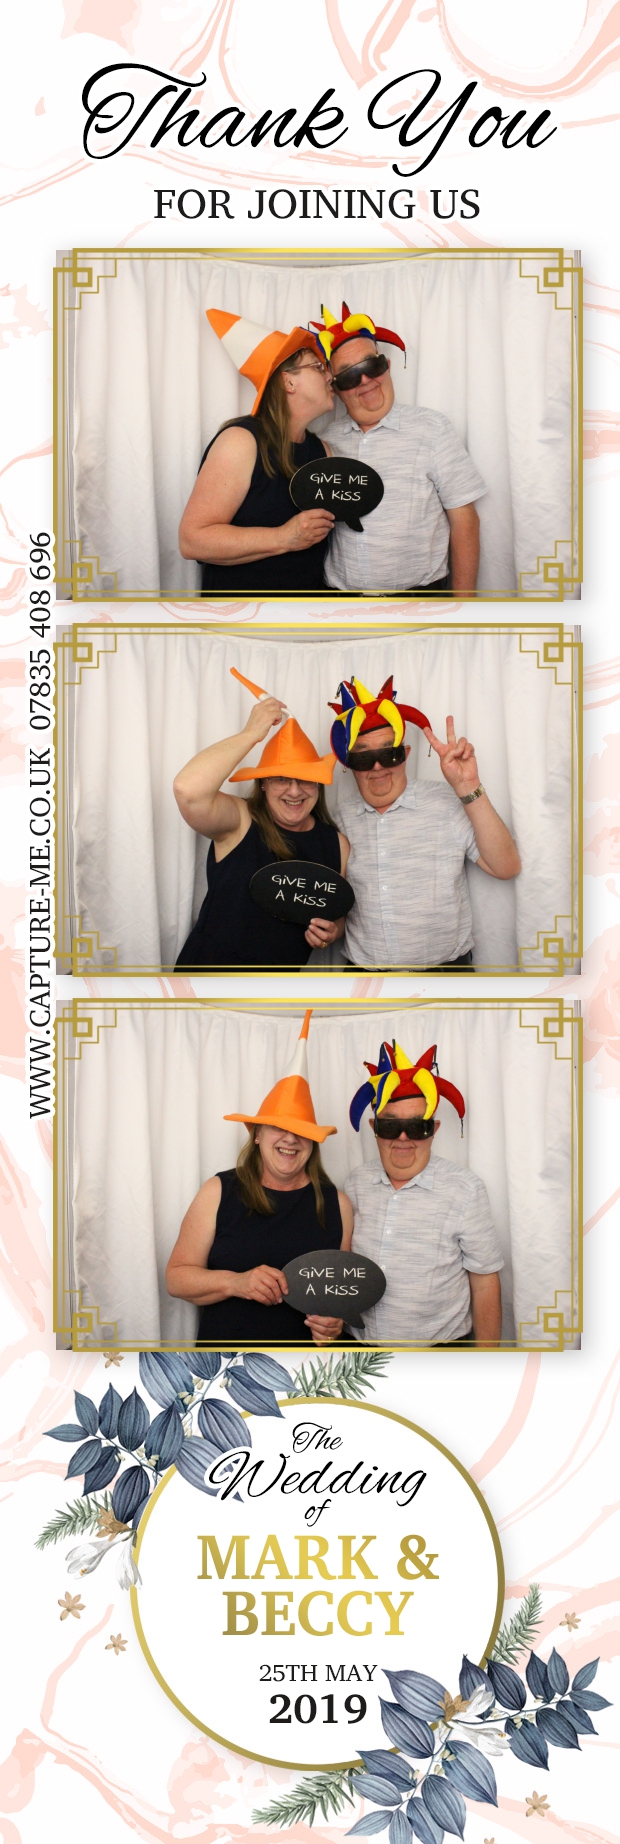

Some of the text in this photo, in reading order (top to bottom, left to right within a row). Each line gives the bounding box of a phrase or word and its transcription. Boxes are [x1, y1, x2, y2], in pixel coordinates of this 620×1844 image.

[348, 474, 369, 486] ME
[315, 488, 324, 500] A
[314, 880, 337, 894] ME
[275, 889, 285, 902] A
[343, 1267, 366, 1279] ME
[305, 1283, 316, 1296] A
